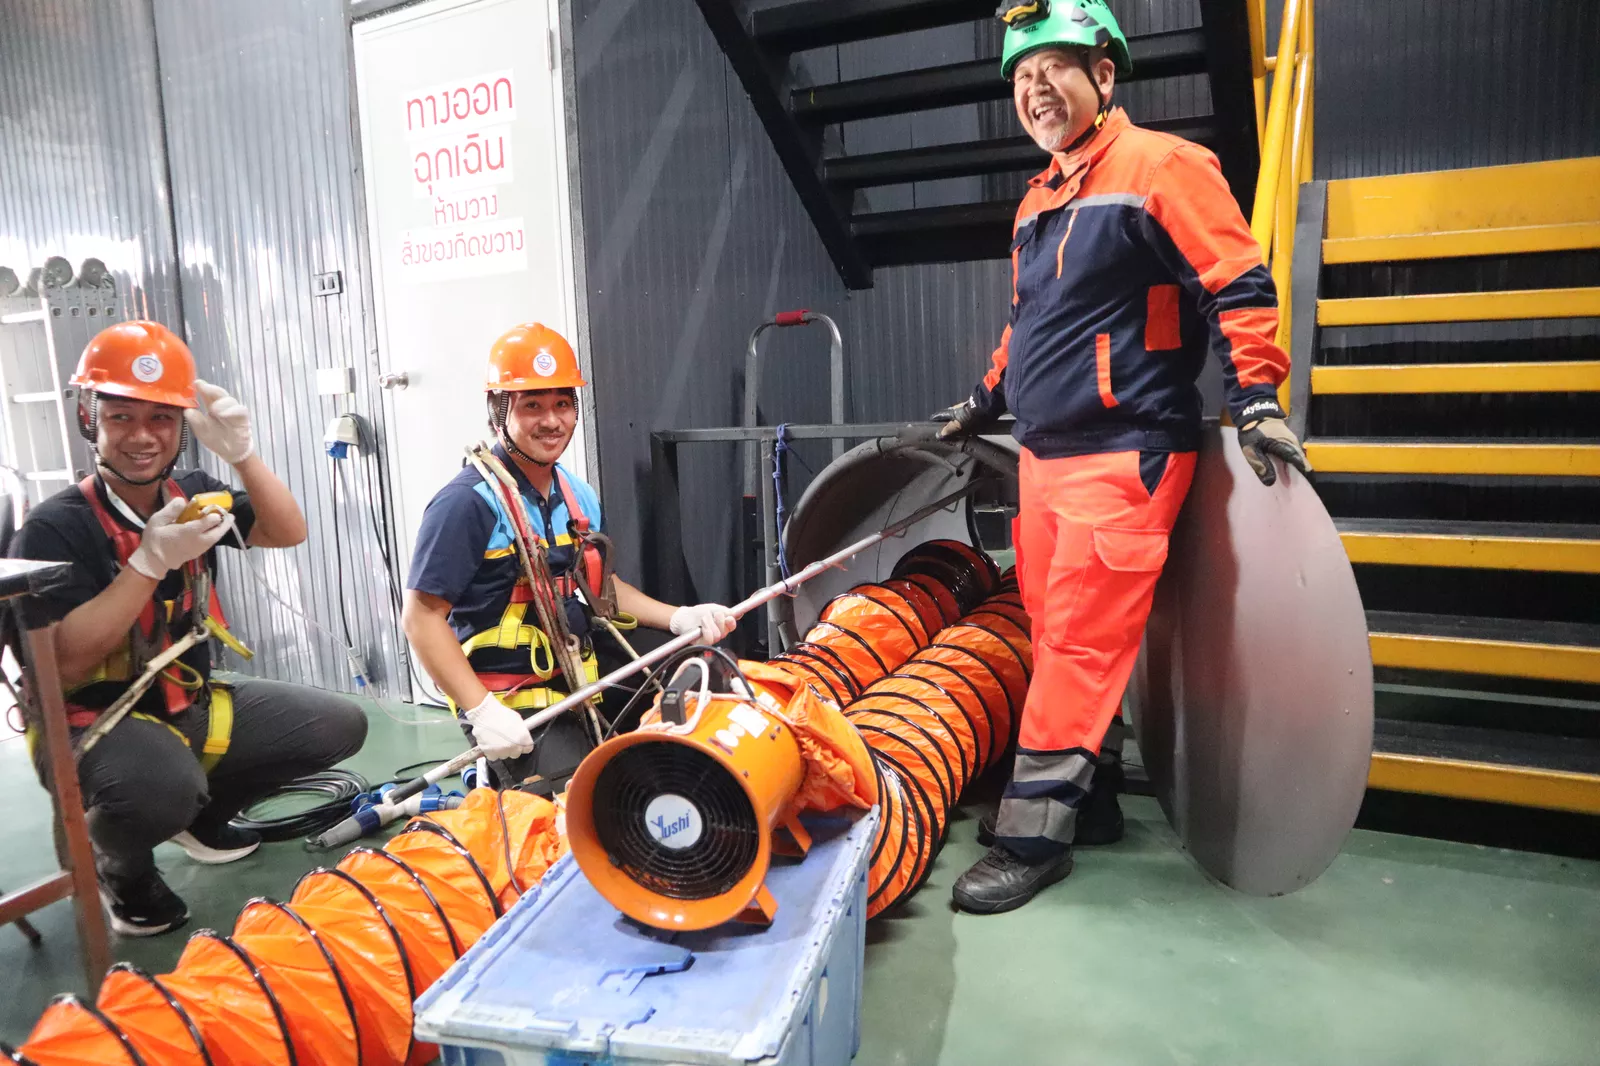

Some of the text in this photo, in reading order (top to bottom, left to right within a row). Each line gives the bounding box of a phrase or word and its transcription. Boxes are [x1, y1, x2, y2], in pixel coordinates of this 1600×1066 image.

[407, 77, 513, 131] ทางออก
[414, 133, 504, 195] ฉุกเฉิน
[434, 194, 498, 225] ห้ามวาง
[402, 229, 523, 266] สิ่งของกีดขวาง
